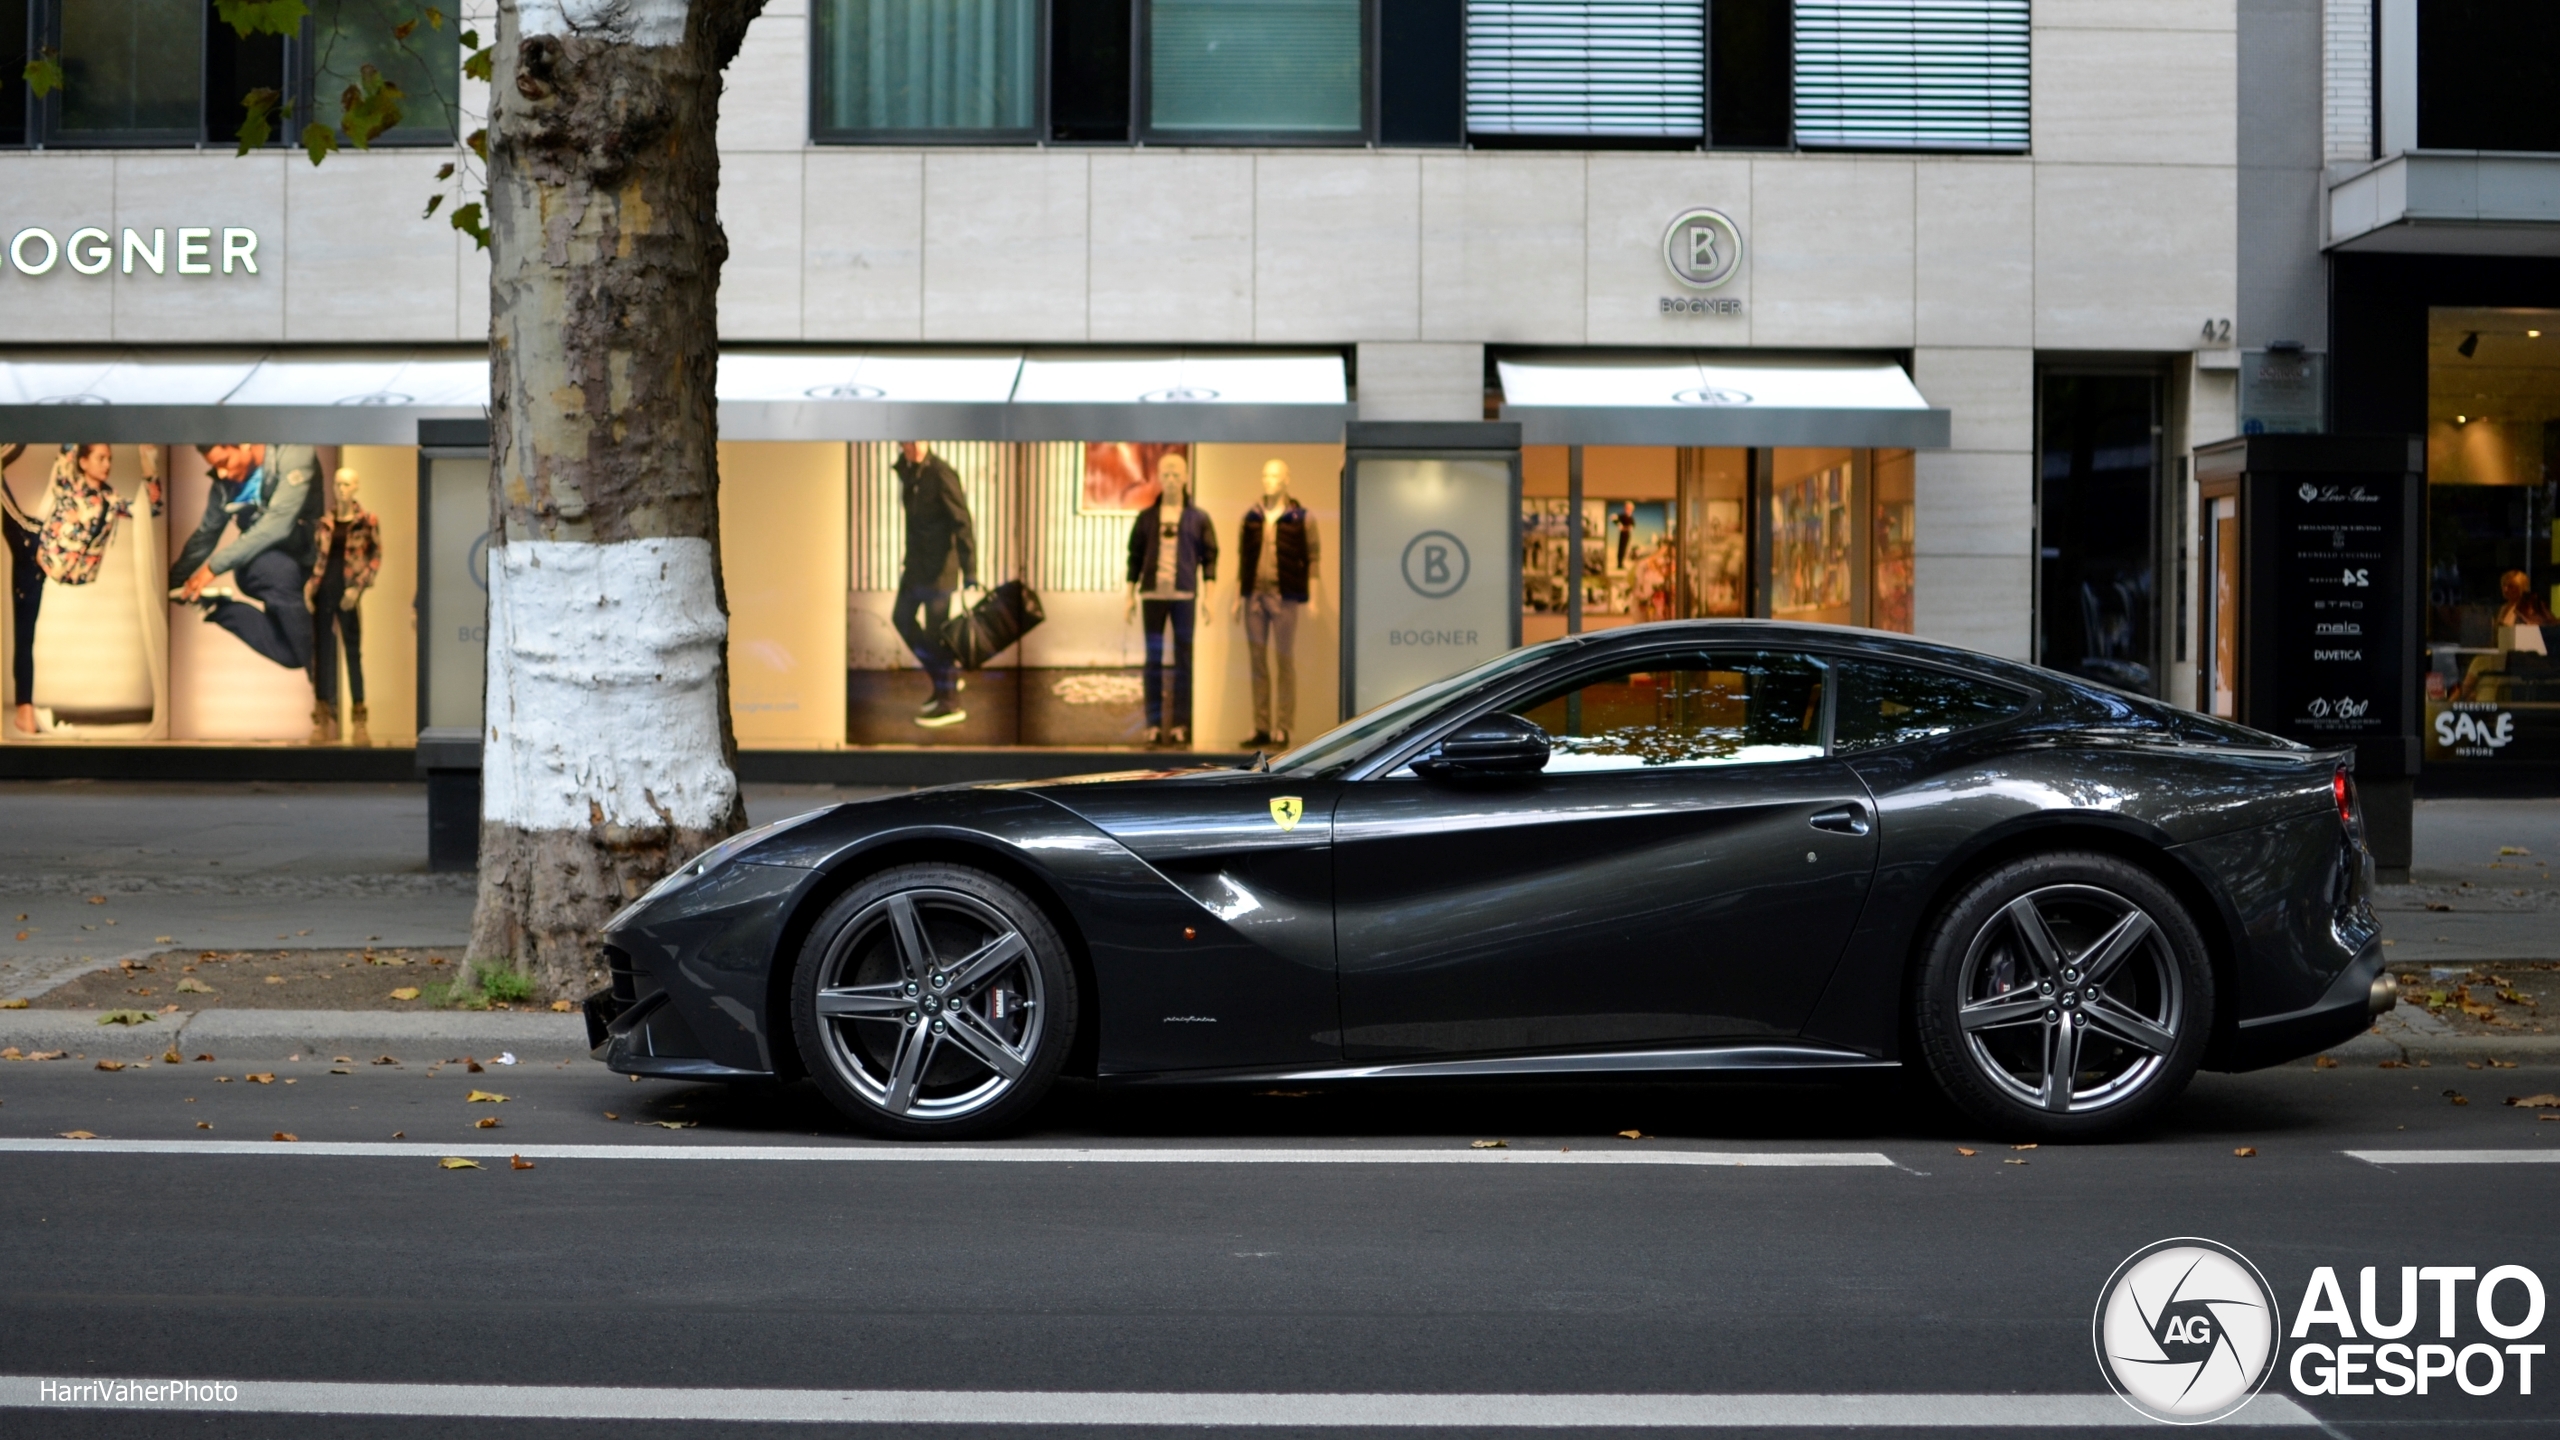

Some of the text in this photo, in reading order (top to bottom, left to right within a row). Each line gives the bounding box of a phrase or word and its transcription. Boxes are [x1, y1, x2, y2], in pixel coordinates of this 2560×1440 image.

[0, 226, 259, 276] OGNER
[1661, 298, 1743, 315] BOGNER
[2202, 318, 2232, 342] 42
[1425, 545, 1451, 584] B
[2314, 600, 2364, 609] ETRO
[2316, 620, 2361, 634] malo
[1390, 629, 1479, 646] BOGNER
[2314, 649, 2362, 661] DUVETICA
[2453, 701, 2498, 712] SELECTED
[2456, 747, 2494, 757] INSTORE
